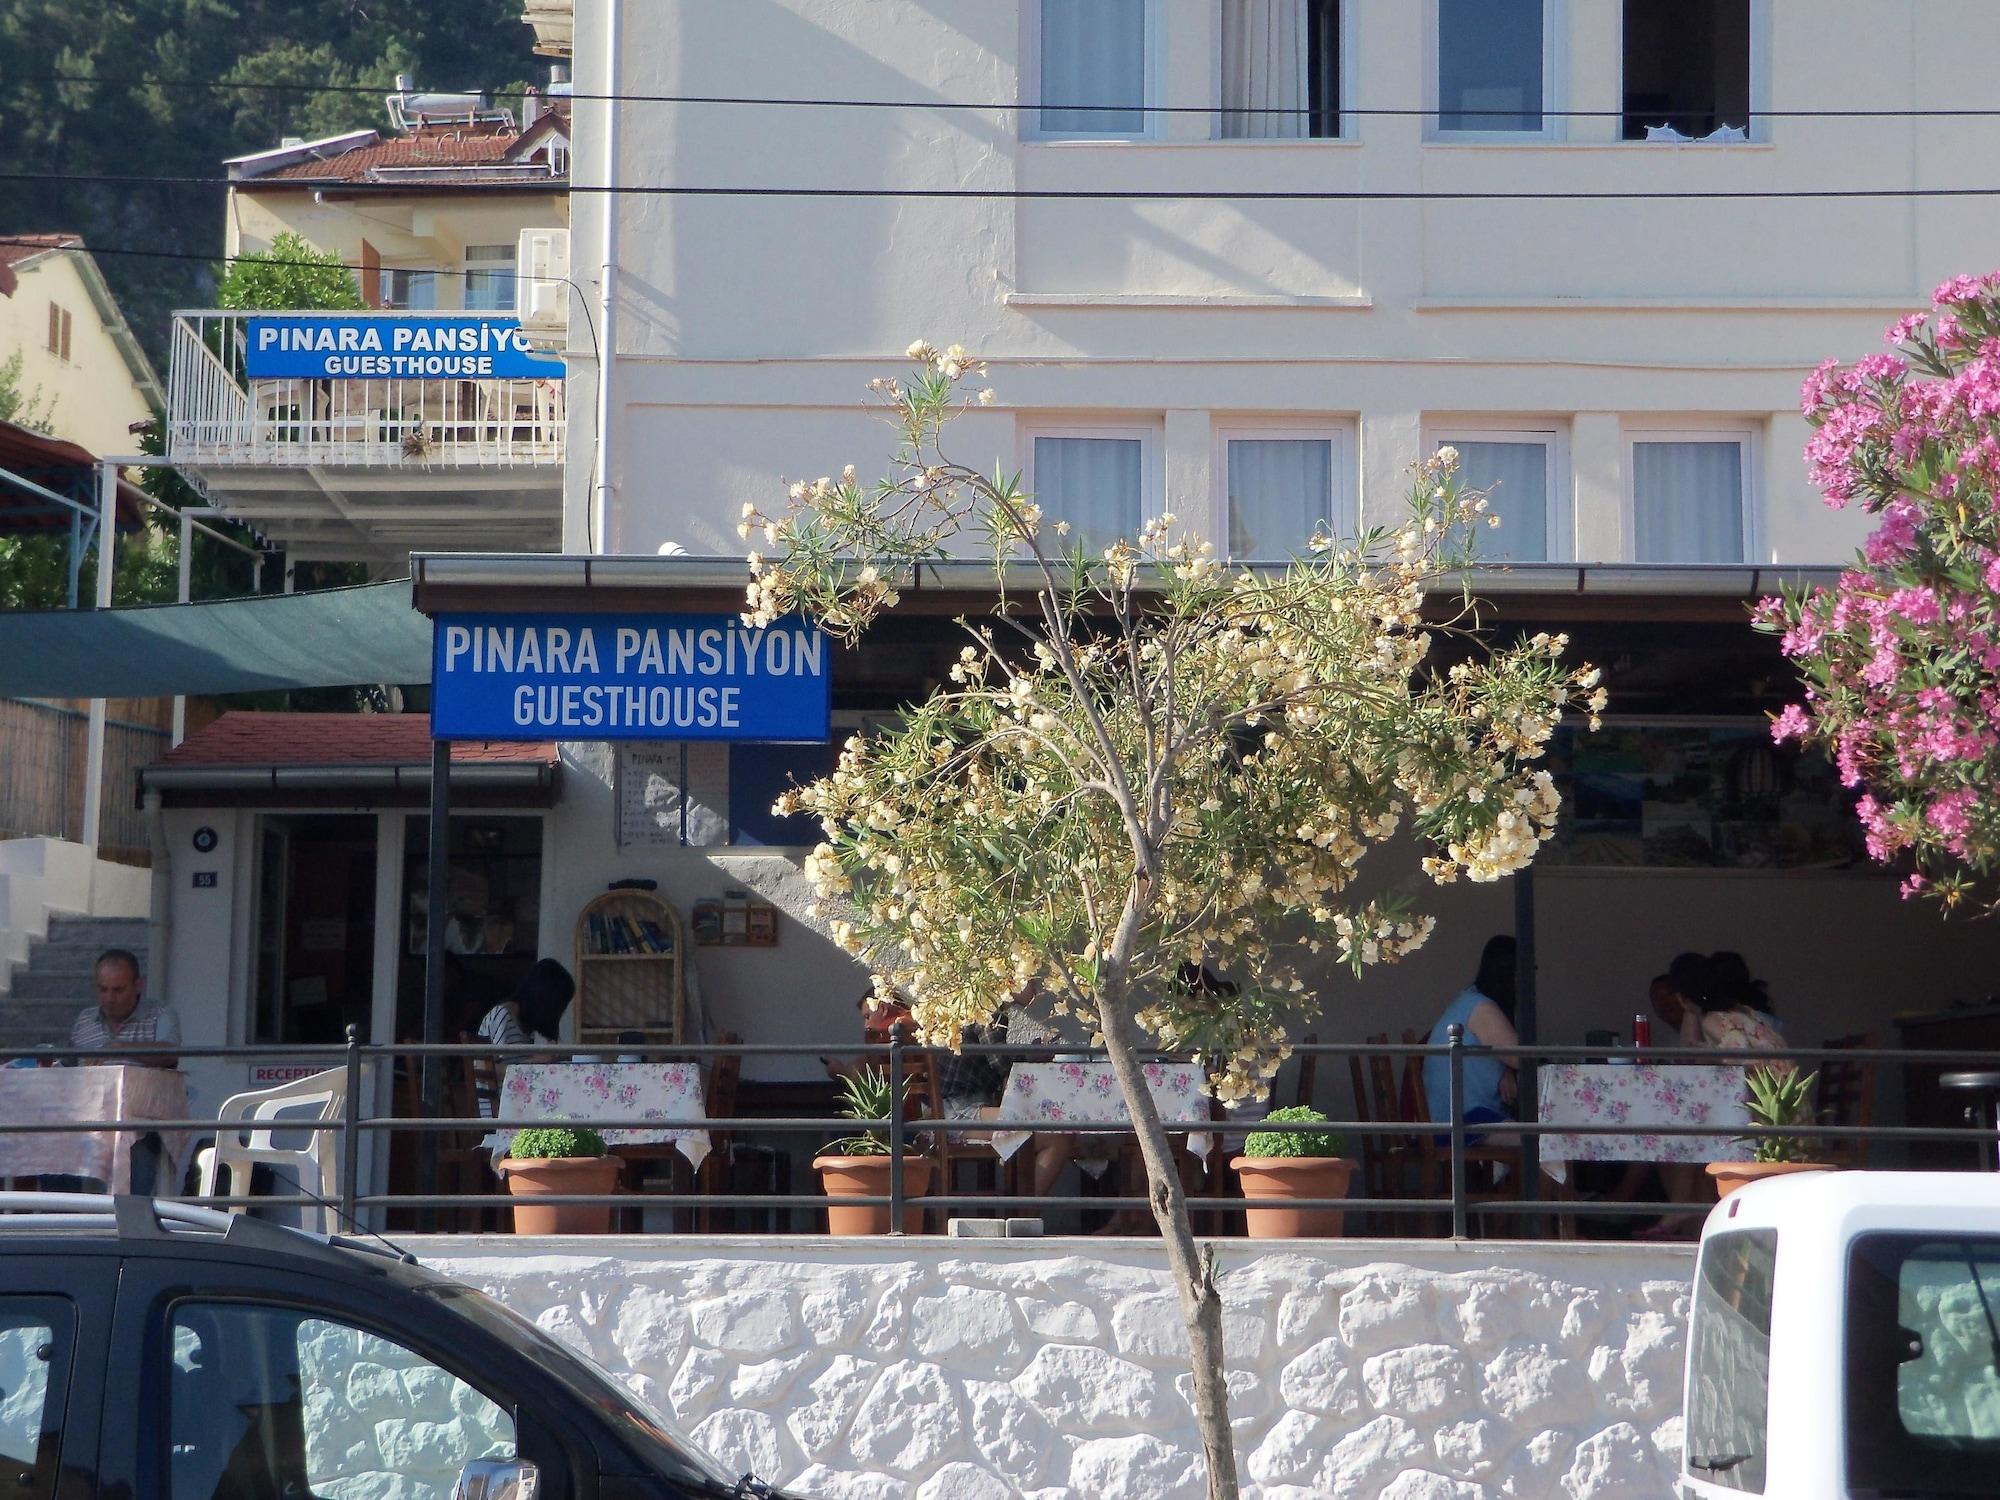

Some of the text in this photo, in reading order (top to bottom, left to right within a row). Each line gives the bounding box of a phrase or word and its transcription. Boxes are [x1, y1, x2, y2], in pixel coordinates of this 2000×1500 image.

[258, 322, 532, 352] PINARA PANSİYO
[324, 355, 493, 376] GUESTHOUSE
[445, 619, 822, 677] PINARA PANSİYON
[513, 684, 741, 728] GUESTHOUSE
[256, 1067, 329, 1080] RECEPTI
